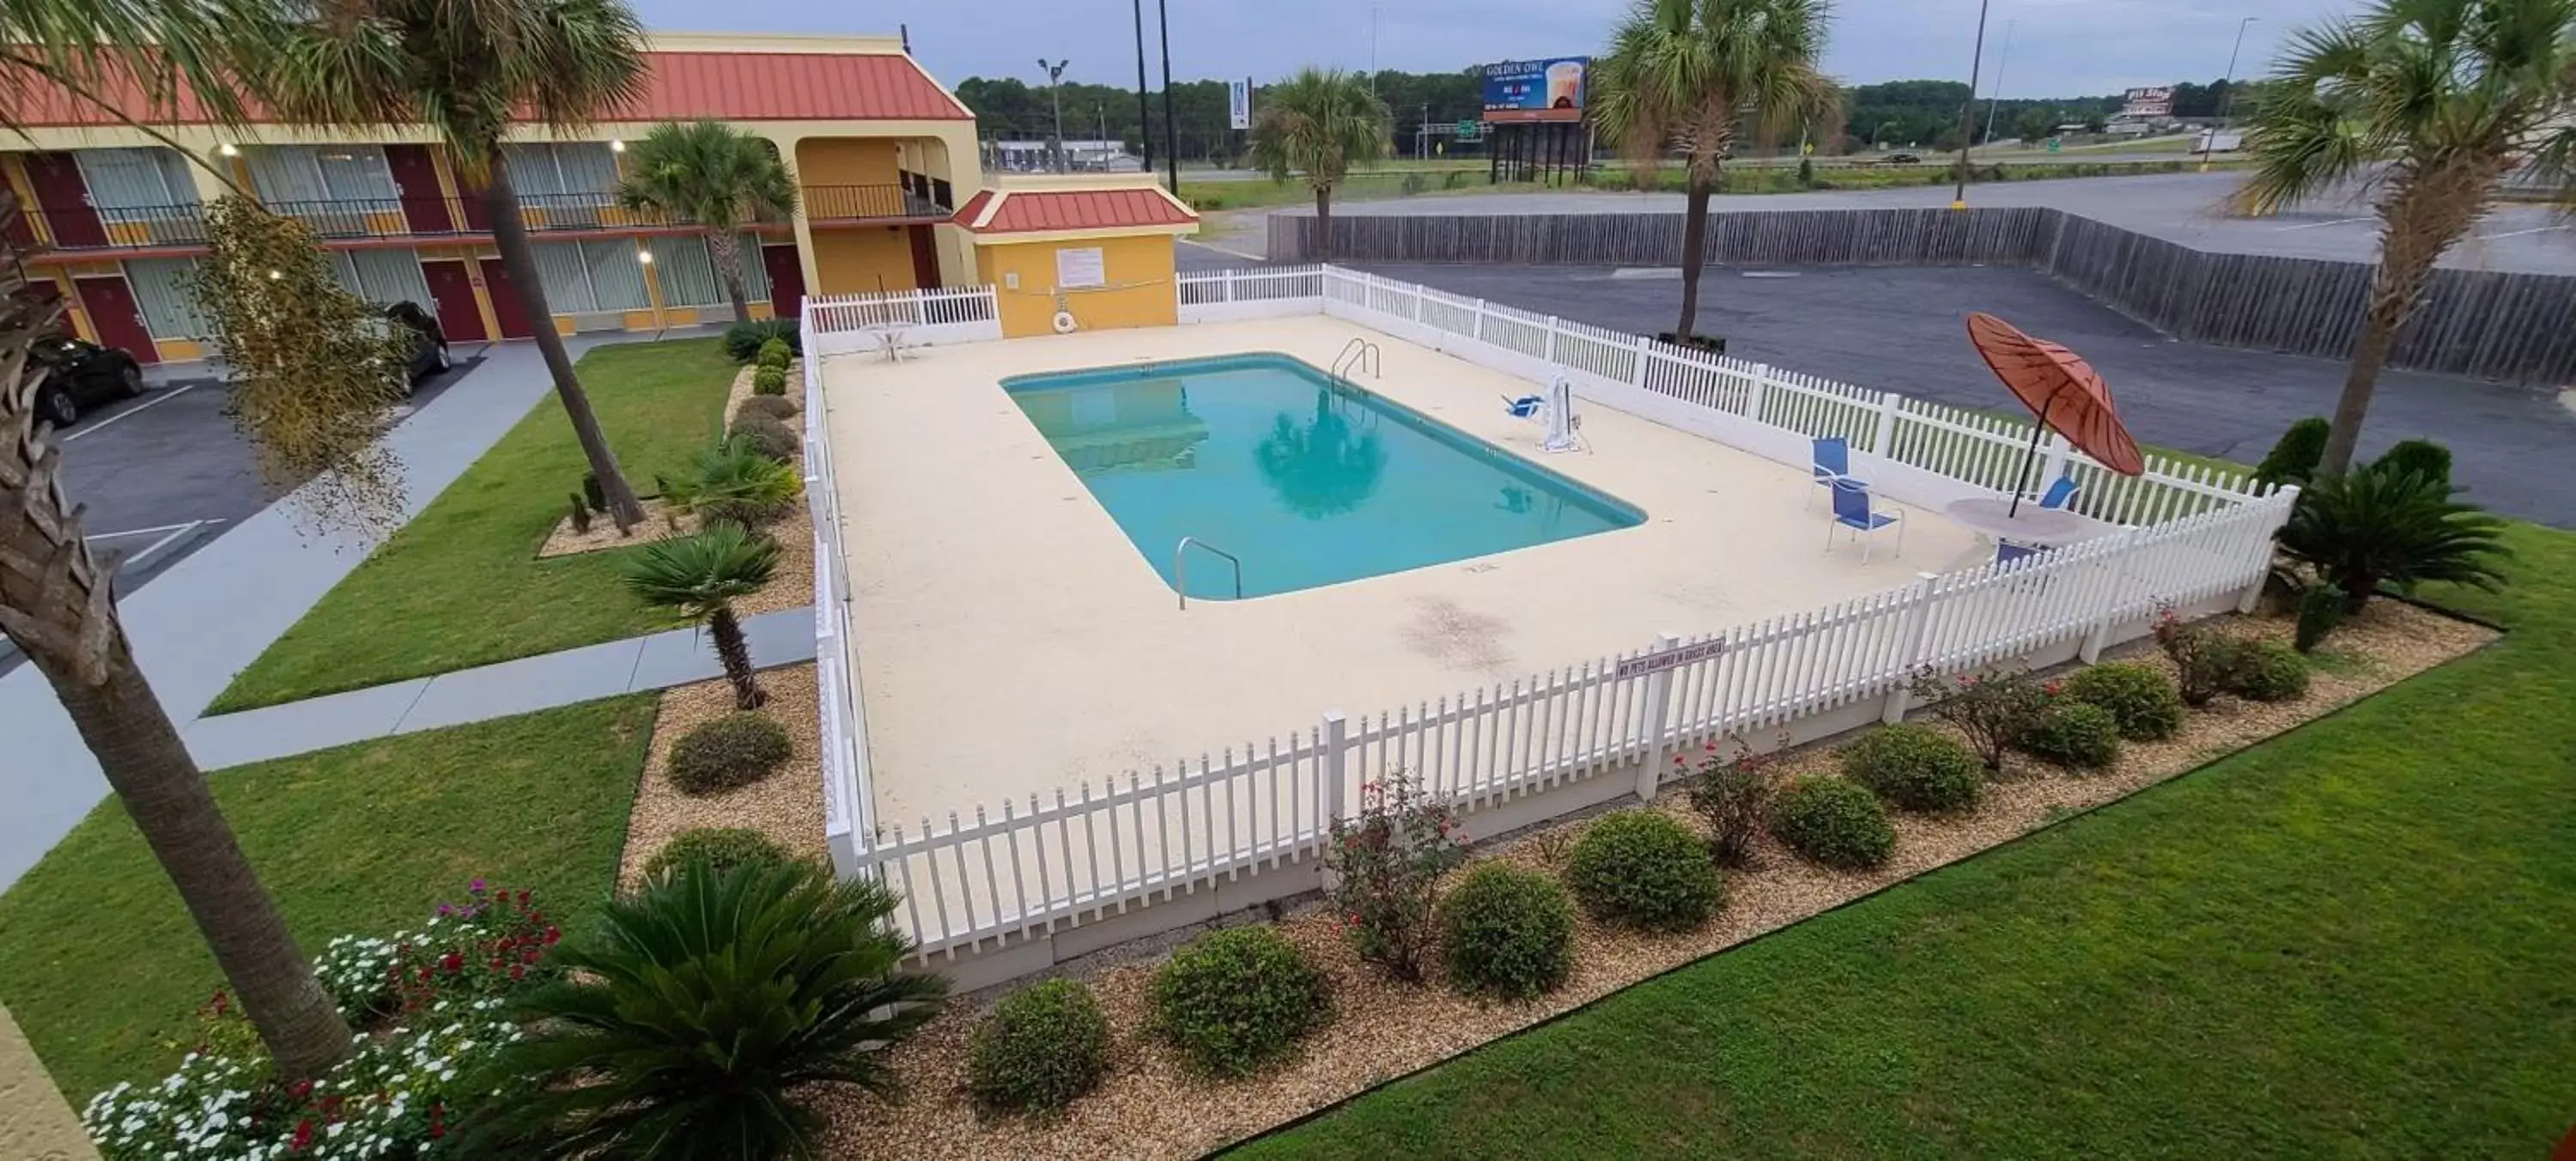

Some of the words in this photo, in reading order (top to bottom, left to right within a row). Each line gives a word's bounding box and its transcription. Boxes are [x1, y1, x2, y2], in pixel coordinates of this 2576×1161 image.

[1486, 64, 1521, 76] GOLDEN
[1524, 63, 1543, 73] OWL
[1619, 666, 1629, 677] NO
[1630, 660, 1646, 673] PETS
[1648, 653, 1675, 669] ALLOWED
[1677, 652, 1684, 663] IN
[1706, 641, 1722, 655] AREA
